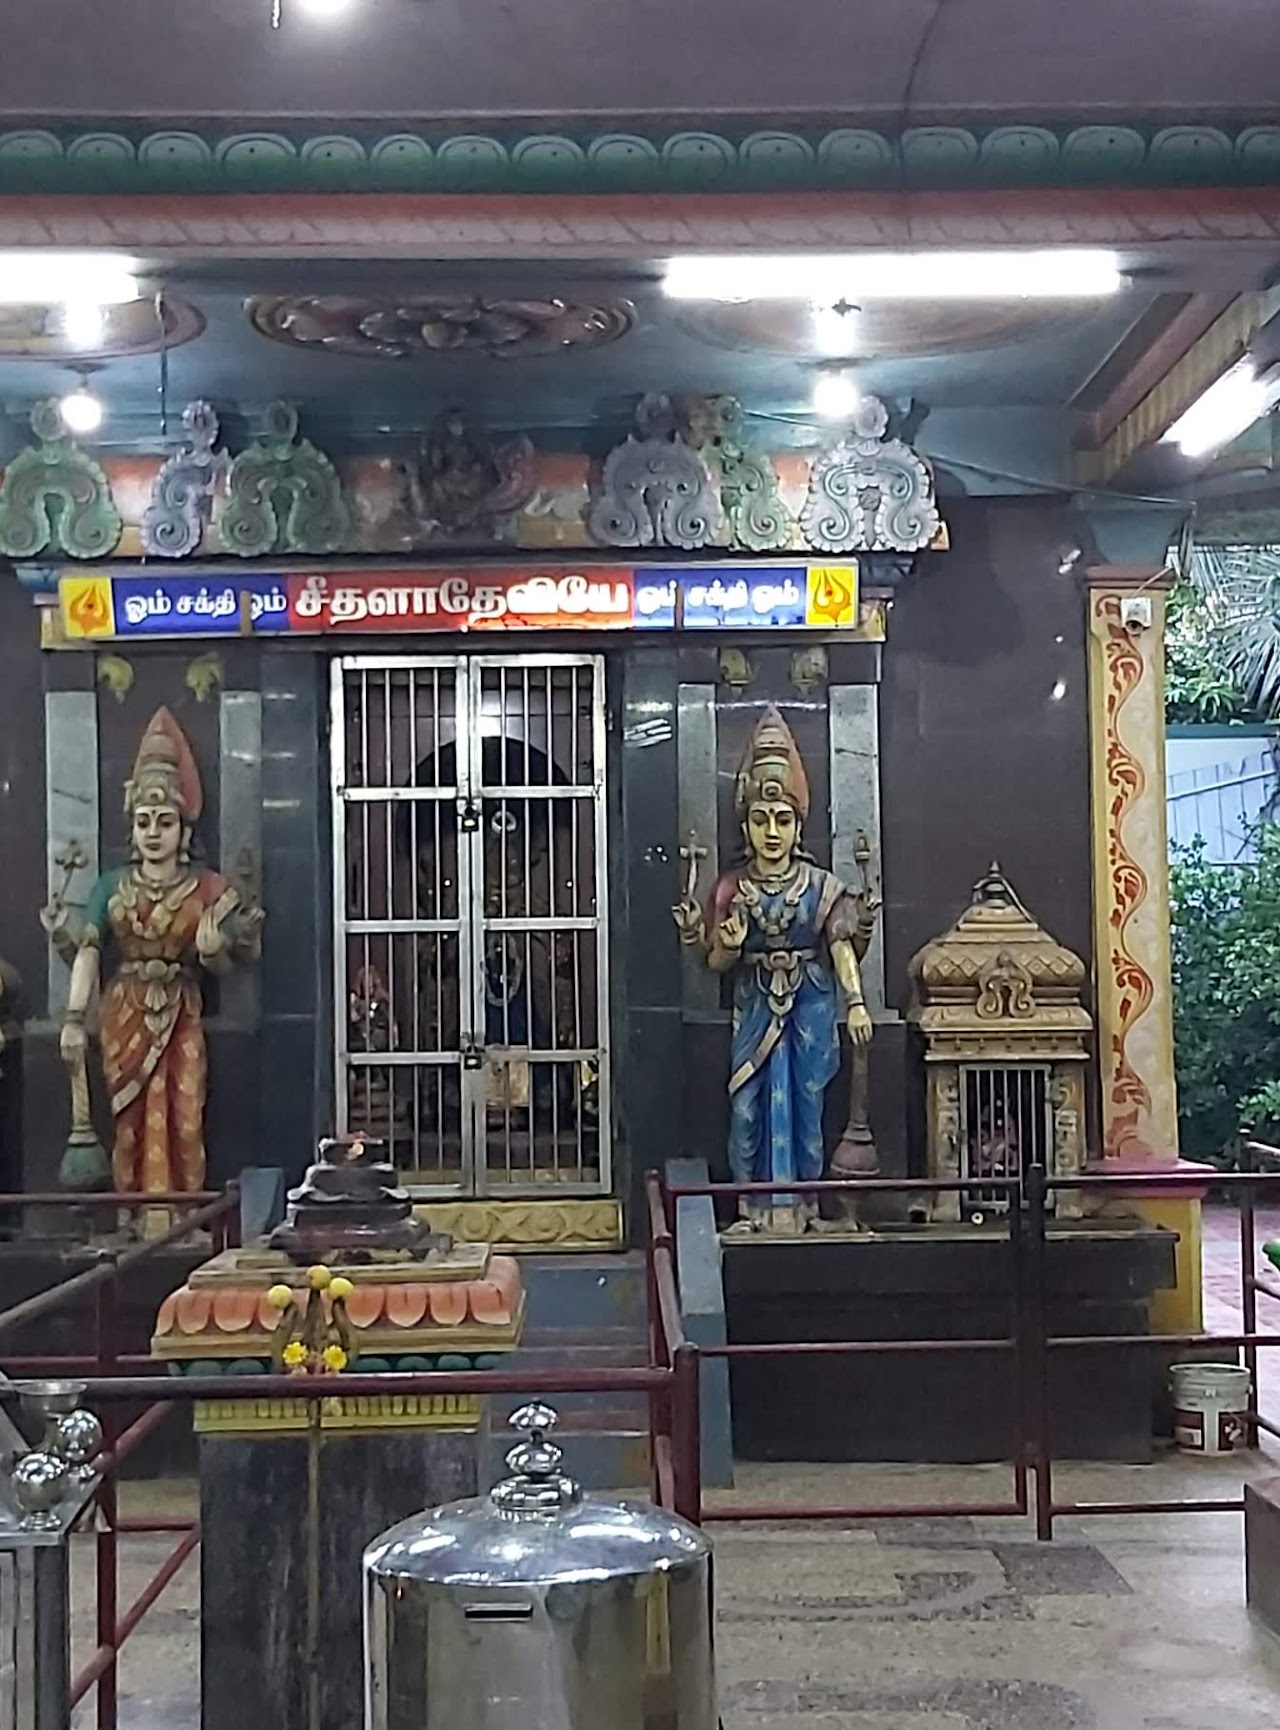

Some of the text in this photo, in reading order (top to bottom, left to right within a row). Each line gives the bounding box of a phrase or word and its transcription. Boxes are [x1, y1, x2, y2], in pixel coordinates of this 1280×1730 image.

[125, 588, 171, 623] ஓம்
[176, 587, 237, 618] சக்தி
[295, 575, 628, 625] சீதளாதேவியே
